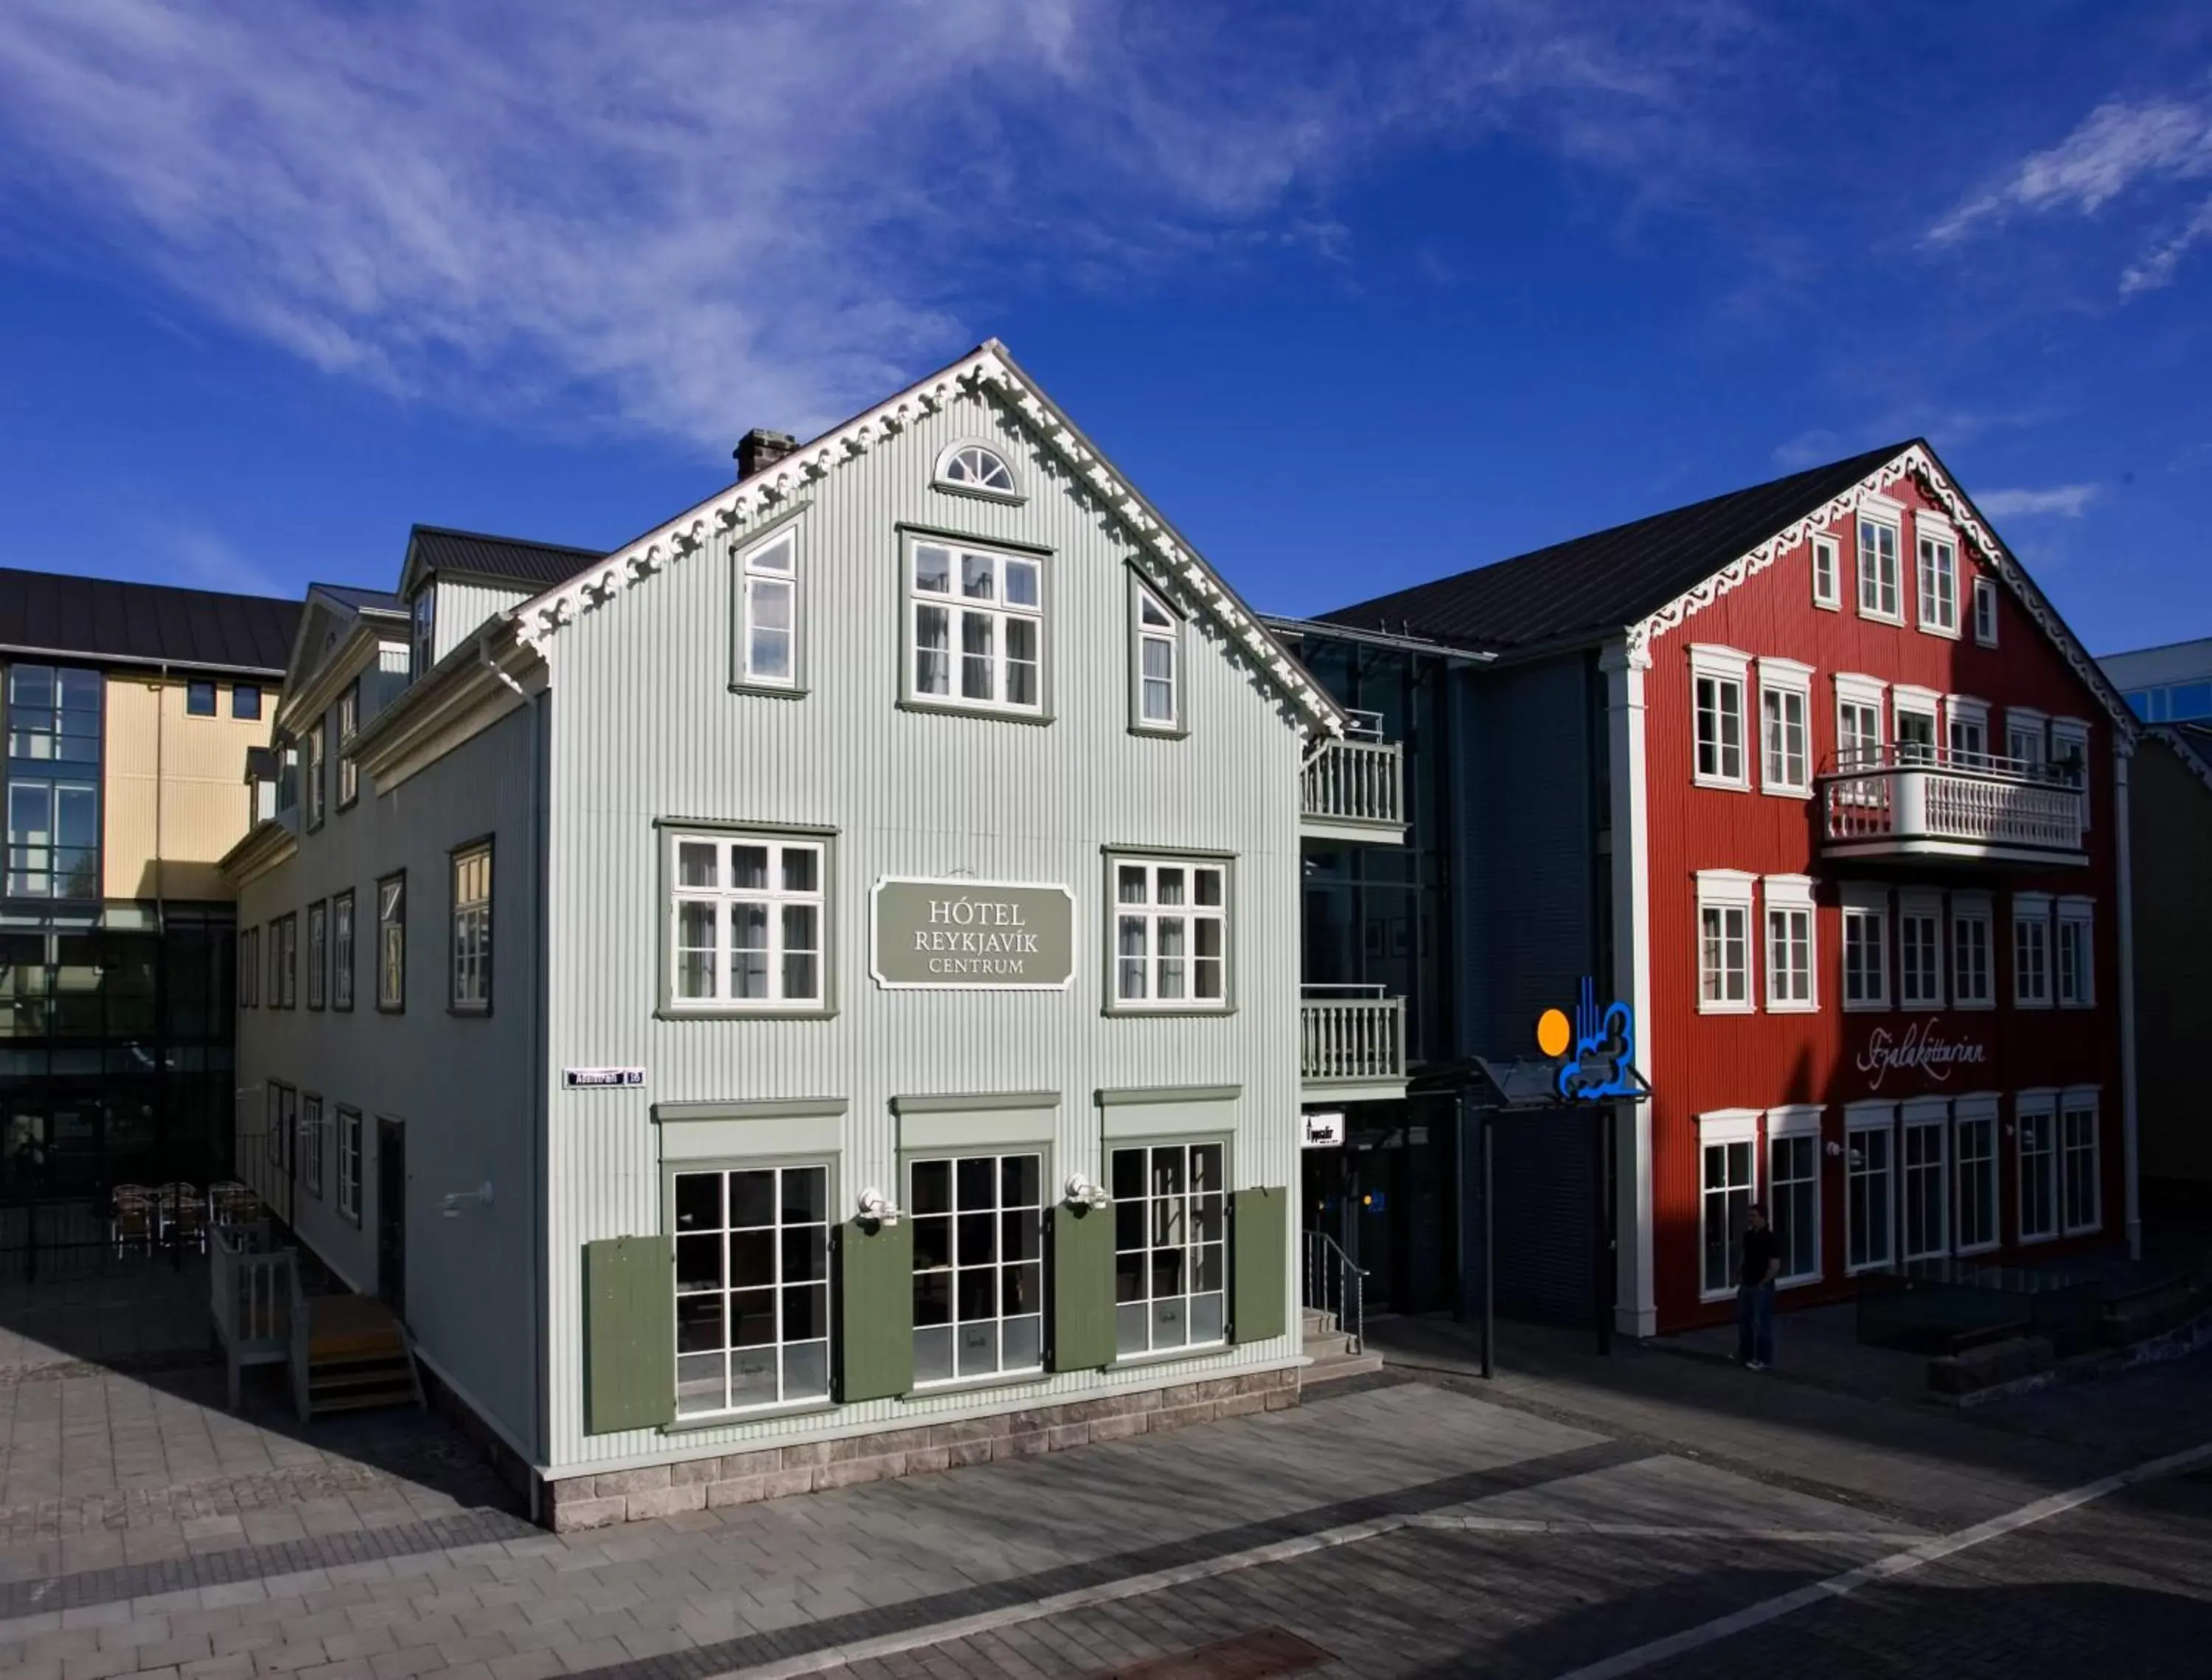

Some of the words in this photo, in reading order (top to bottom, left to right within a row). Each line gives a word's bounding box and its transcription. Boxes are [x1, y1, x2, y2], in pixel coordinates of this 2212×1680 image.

[928, 896, 1026, 926] HÓTEL
[914, 929, 1038, 956] REYKJAVÍK
[928, 958, 1023, 974] CENTRUM
